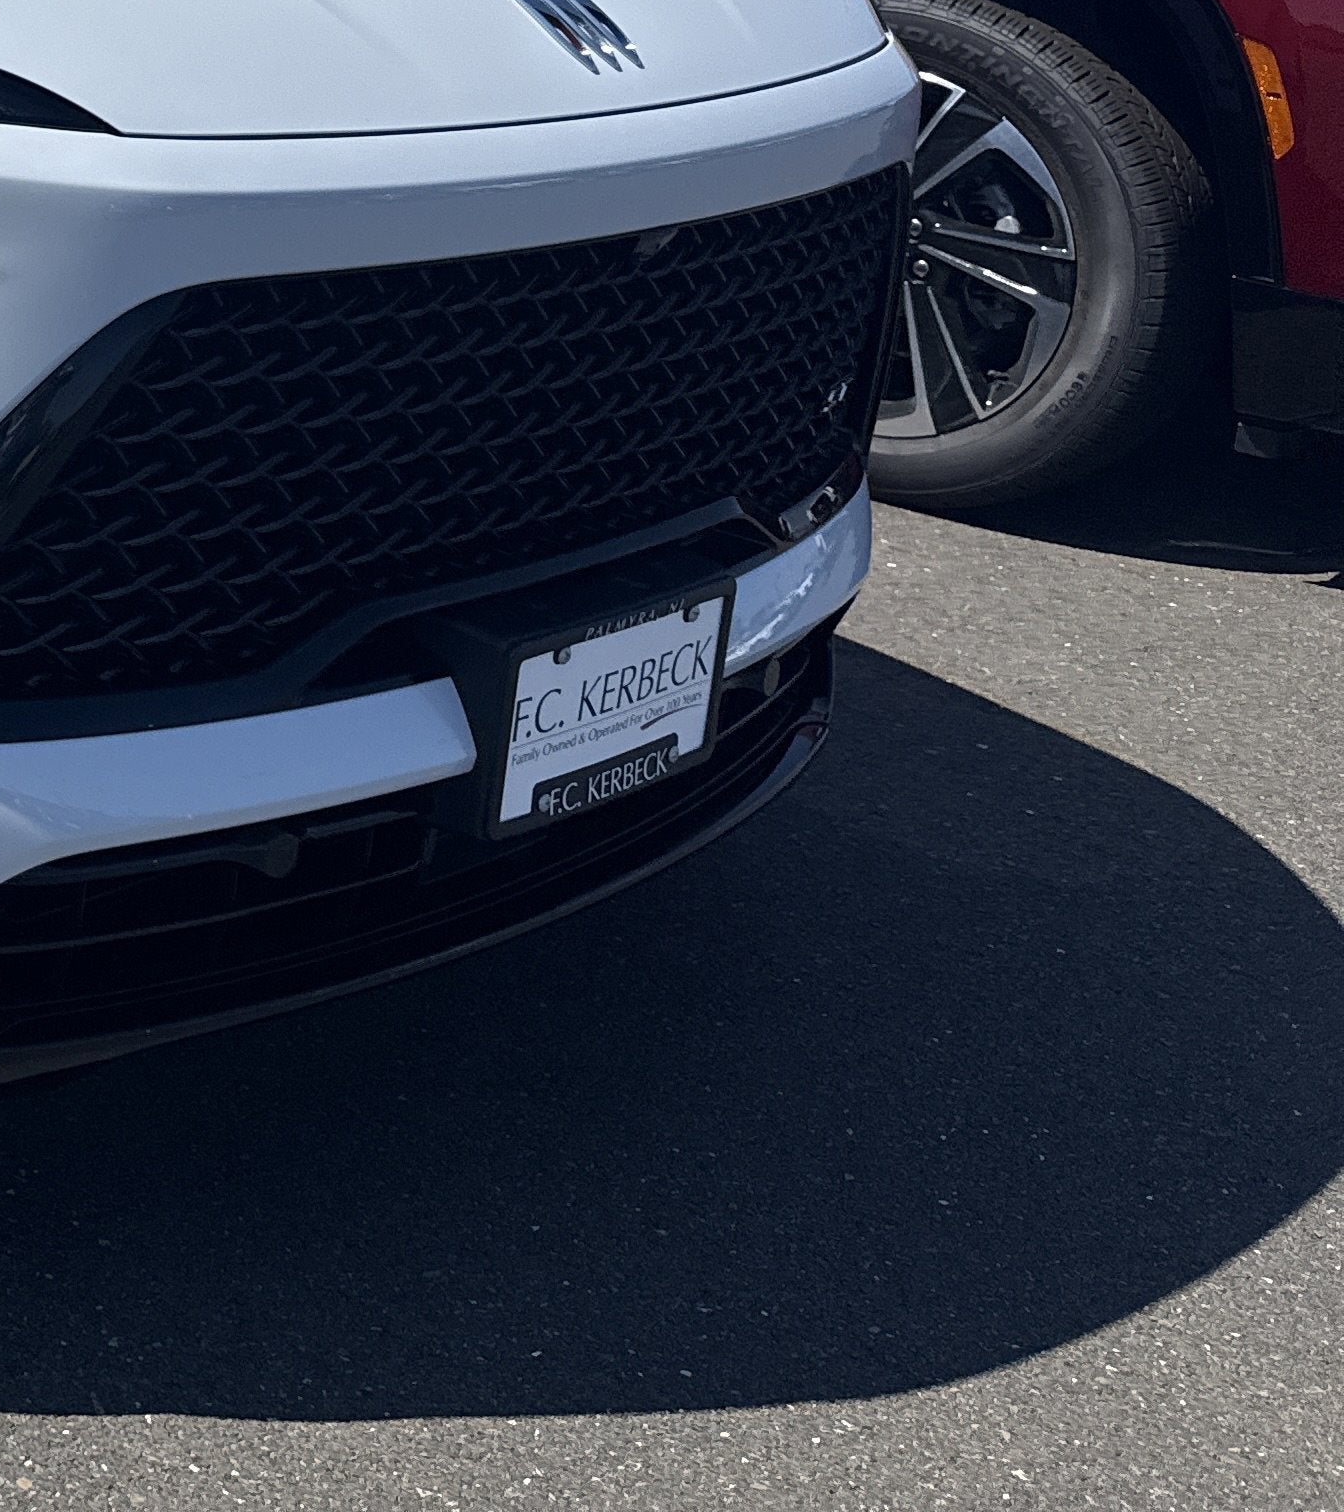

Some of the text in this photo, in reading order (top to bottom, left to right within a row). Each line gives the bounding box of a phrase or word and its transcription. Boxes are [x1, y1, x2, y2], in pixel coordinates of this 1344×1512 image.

[512, 635, 713, 742] F.C. KERBECK
[512, 747, 541, 767] Family
[543, 737, 577, 756] Owned
[588, 719, 628, 742] Operated
[549, 746, 668, 816] F.C. KERBECK
